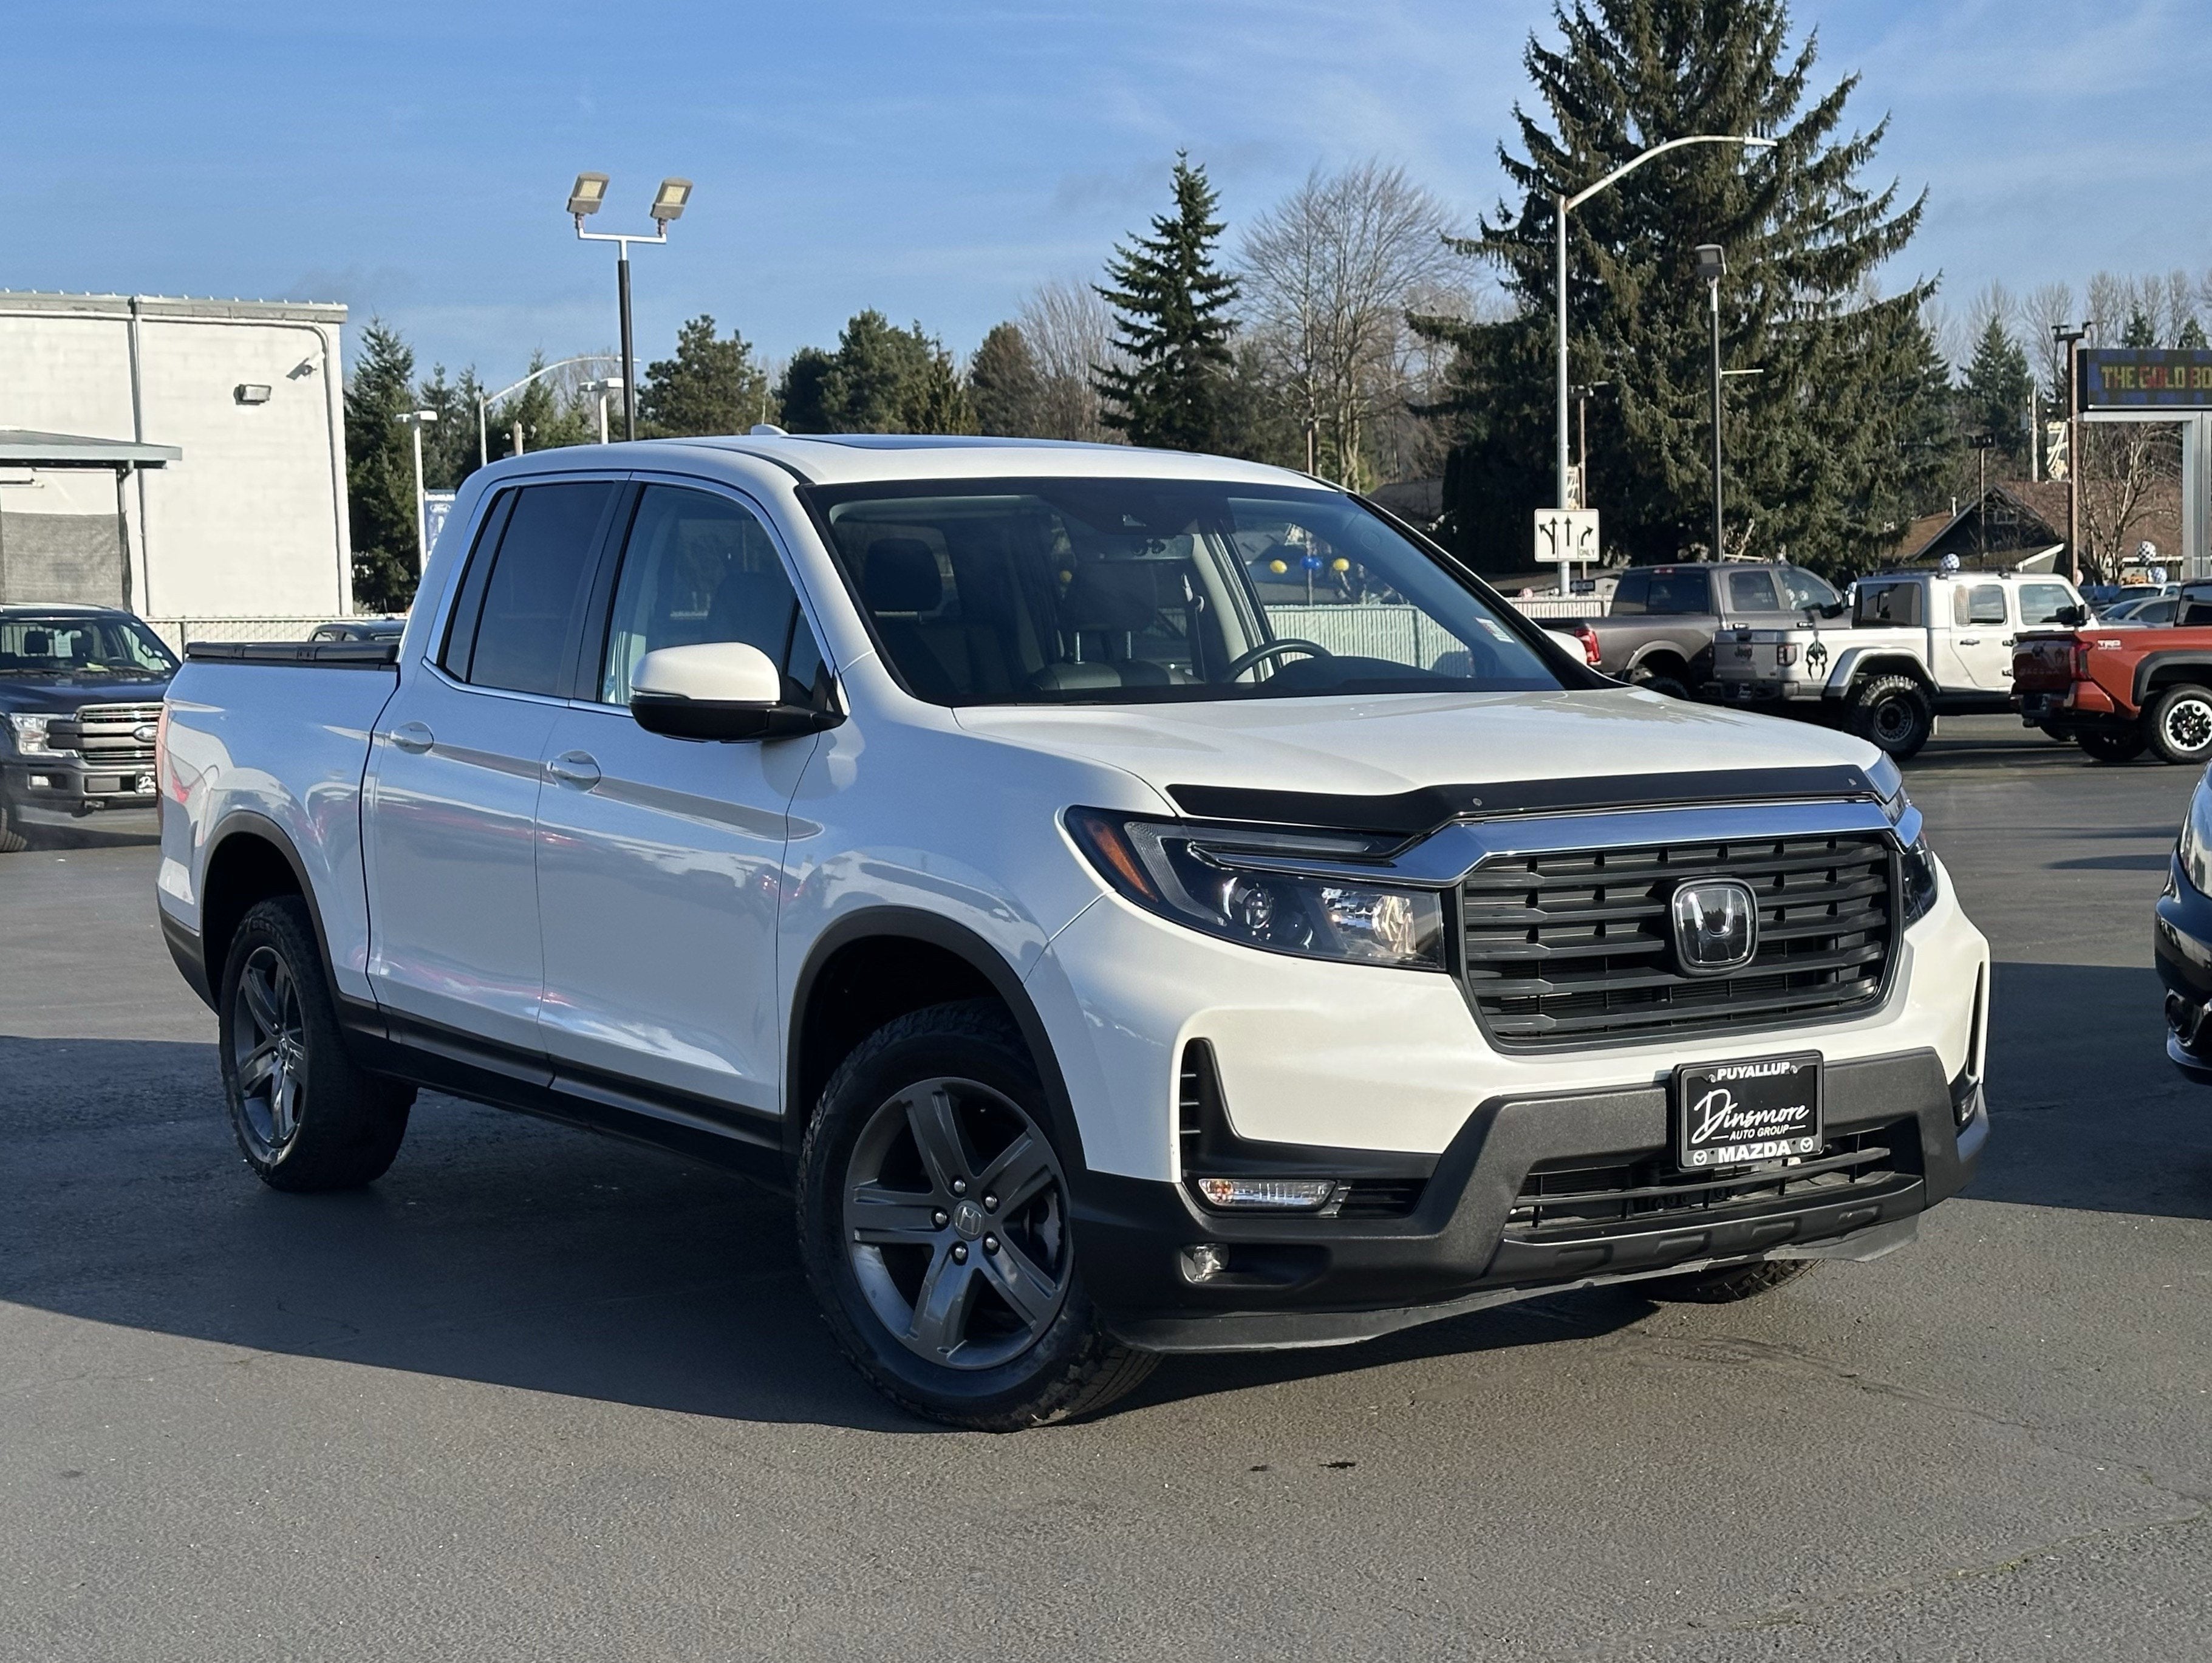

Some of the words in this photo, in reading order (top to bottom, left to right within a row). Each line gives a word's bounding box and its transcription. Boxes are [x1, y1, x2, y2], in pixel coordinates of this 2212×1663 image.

[2101, 366, 2135, 388] THE
[2139, 366, 2185, 389] GOLD
[1717, 1062, 1790, 1081] PUYALLUP
[1691, 1088, 1809, 1144] Dinsmore
[1729, 1128, 1755, 1141] AUTO
[1757, 1124, 1790, 1138] GROUP
[1718, 1140, 1792, 1163] MAZDA
